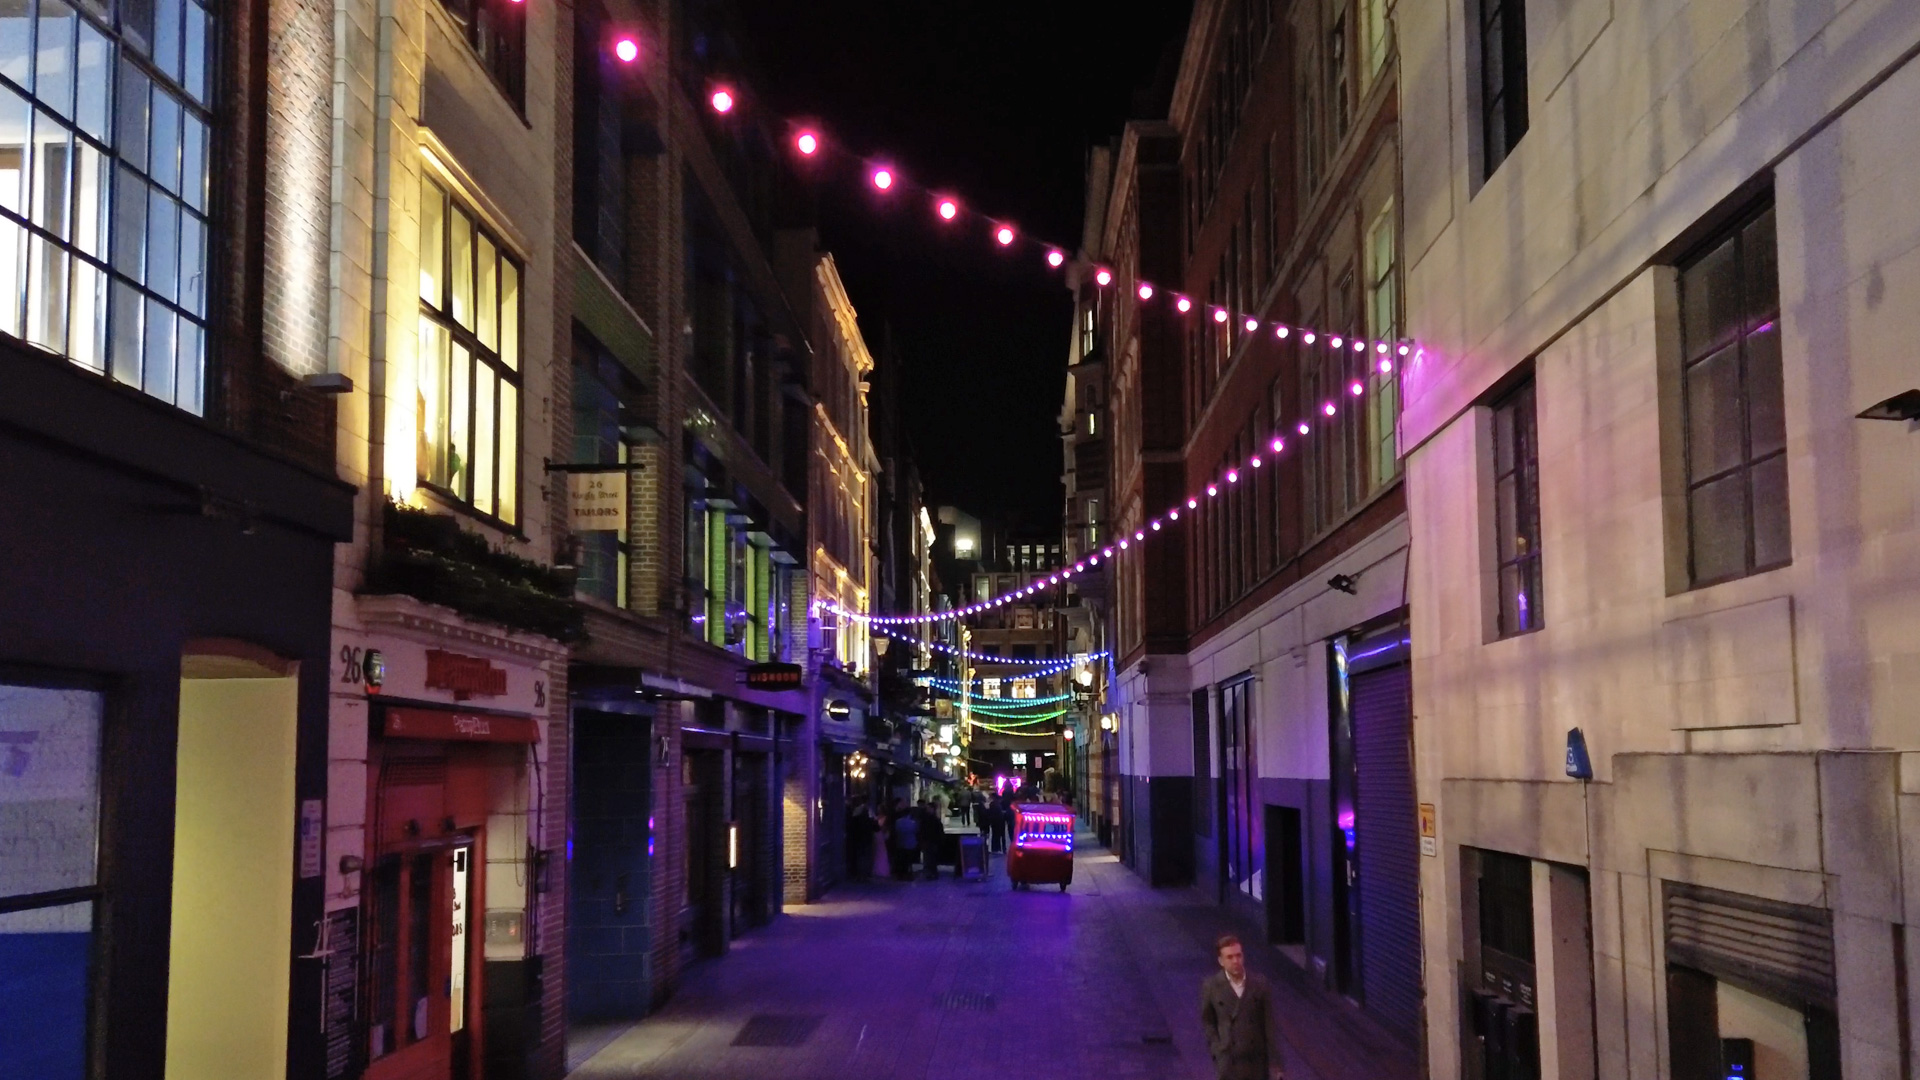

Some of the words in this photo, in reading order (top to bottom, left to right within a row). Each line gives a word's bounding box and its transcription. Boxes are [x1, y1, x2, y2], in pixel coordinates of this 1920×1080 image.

[573, 508, 619, 517] TAILORS
[341, 645, 361, 684] 26
[534, 681, 545, 708] 26
